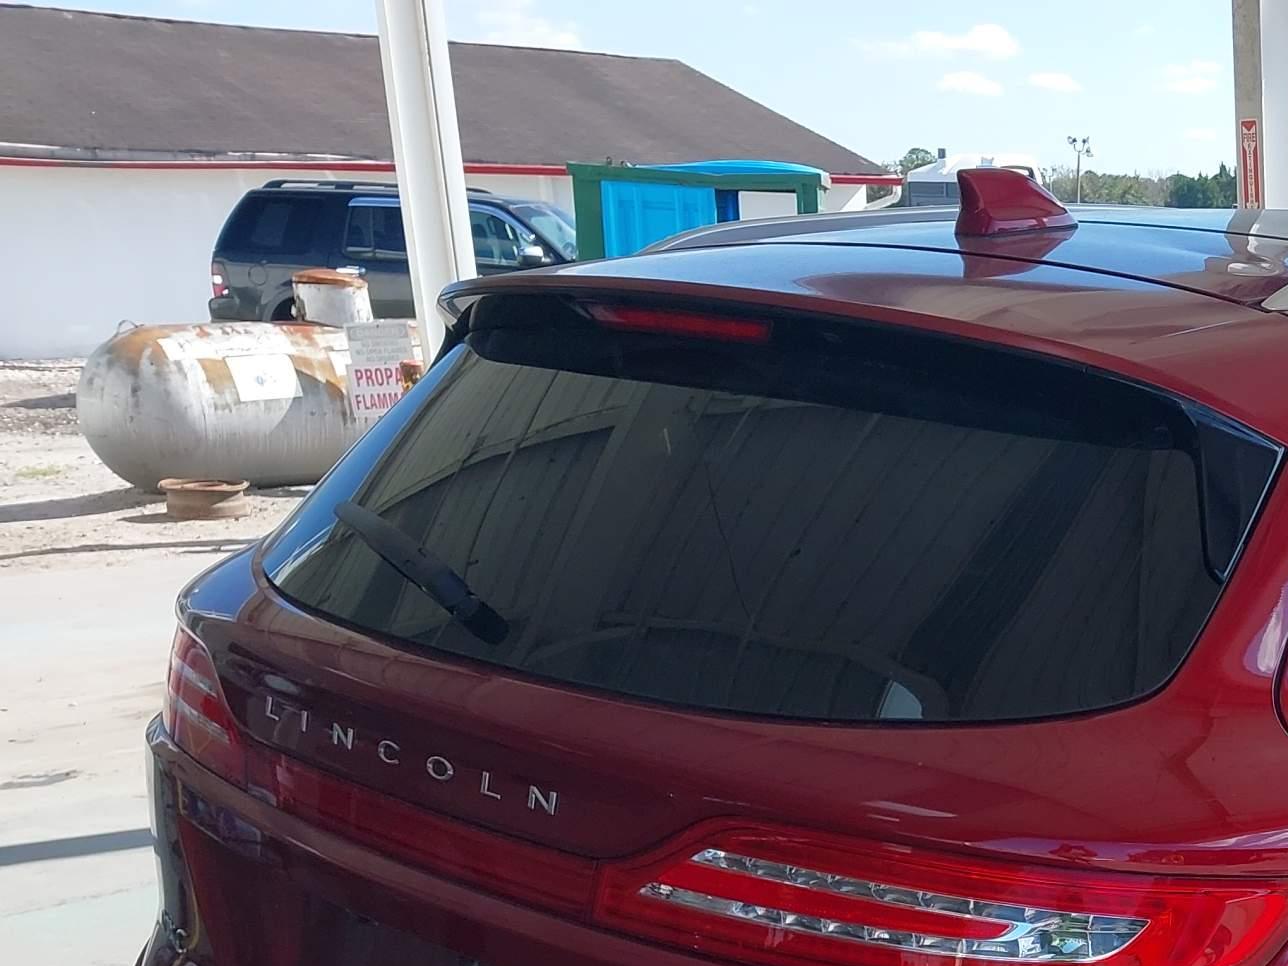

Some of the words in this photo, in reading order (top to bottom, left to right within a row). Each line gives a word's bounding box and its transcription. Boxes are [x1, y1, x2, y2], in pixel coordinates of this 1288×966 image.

[1243, 133, 1256, 142] FIRE
[354, 391, 403, 411] FLAMM
[264, 695, 559, 816] LINCOLN
